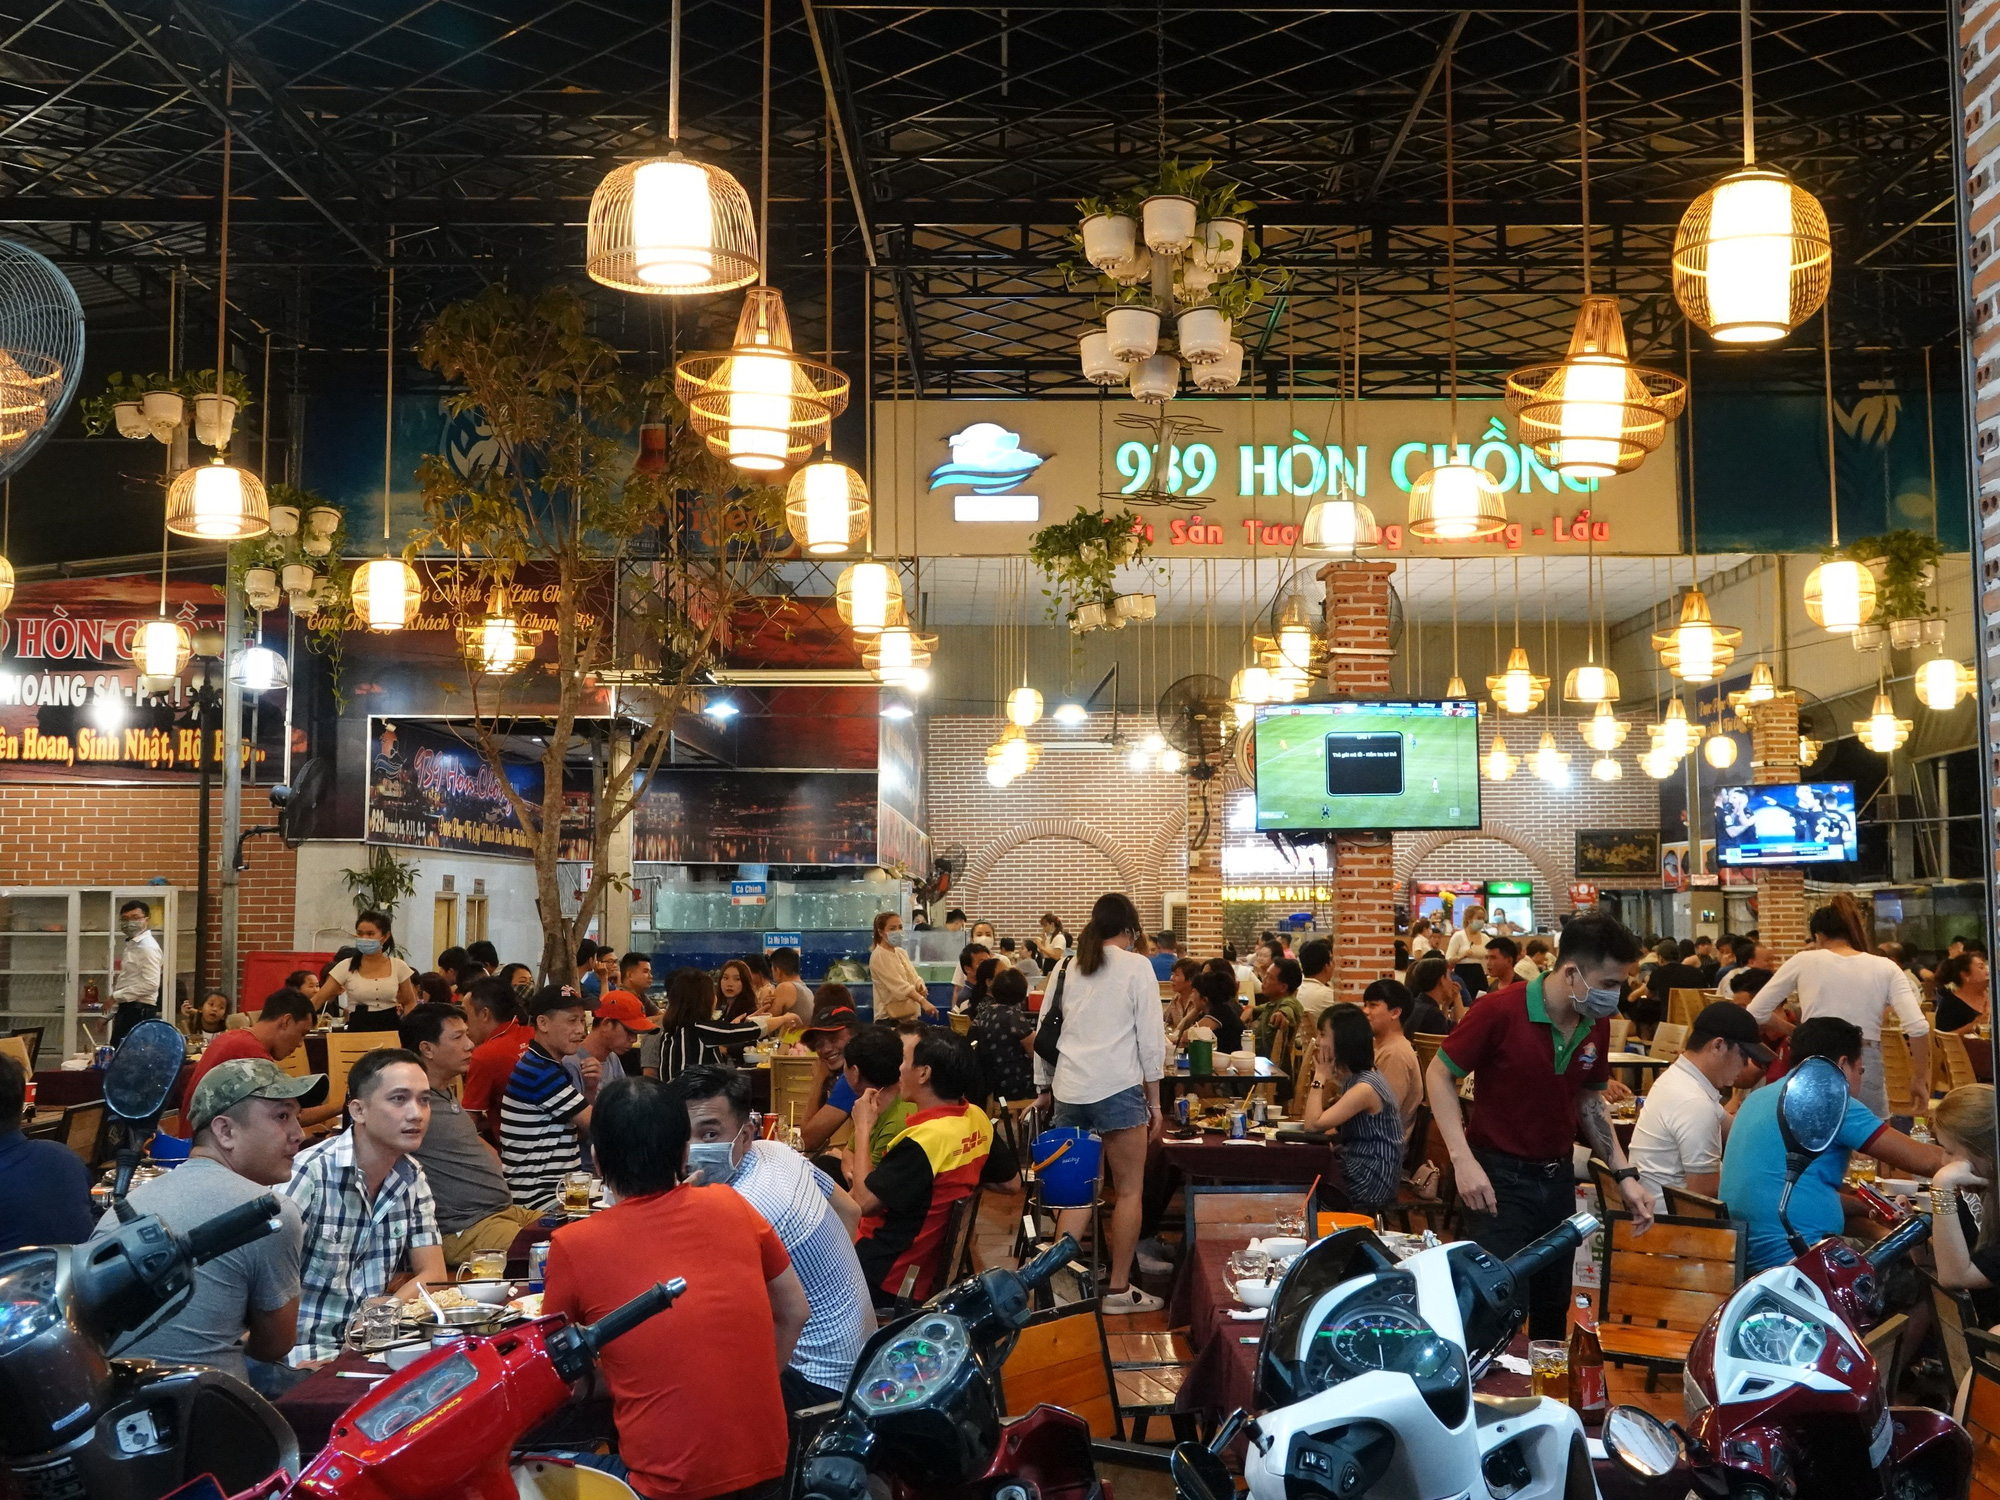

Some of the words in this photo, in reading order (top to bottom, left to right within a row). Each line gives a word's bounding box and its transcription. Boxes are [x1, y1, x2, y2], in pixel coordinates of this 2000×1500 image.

[1238, 428, 1368, 497] HÒN
[1390, 416, 1599, 495] CỒN
[1170, 514, 1224, 546] Sản
[1553, 508, 1610, 543] Lẩu
[14, 603, 107, 661] HÒN
[22, 727, 75, 768] Hoan,
[77, 726, 121, 761] Sinh
[124, 726, 175, 769] Nhật,
[178, 727, 202, 769] Hộ
